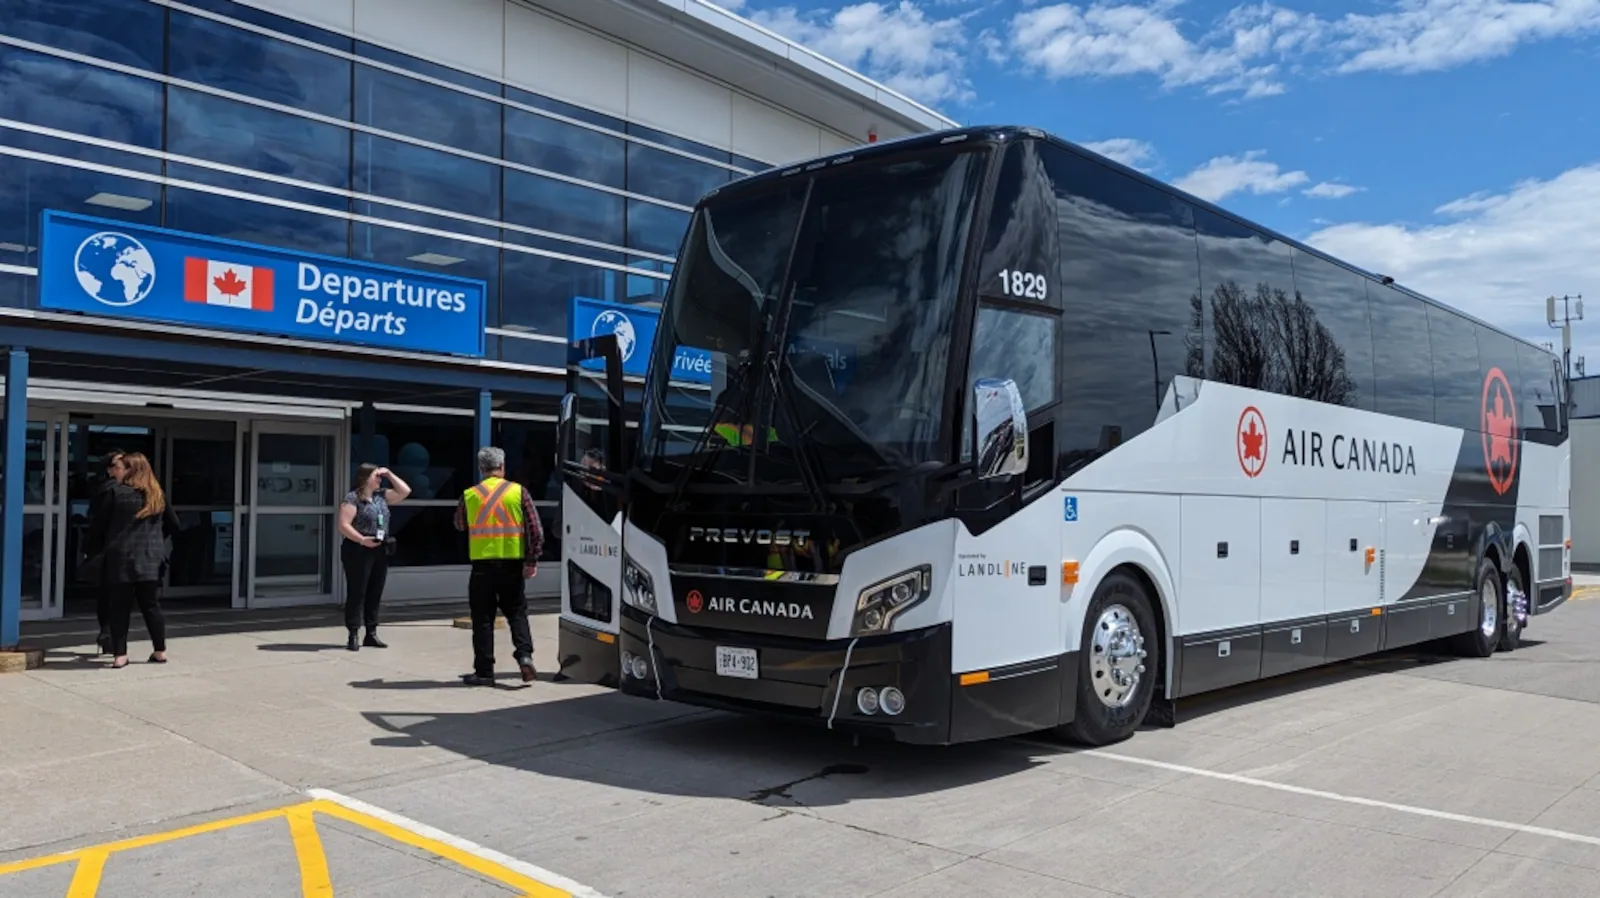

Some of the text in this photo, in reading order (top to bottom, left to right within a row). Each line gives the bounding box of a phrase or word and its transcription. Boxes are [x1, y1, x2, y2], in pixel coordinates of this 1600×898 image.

[298, 262, 466, 313] Departures
[999, 269, 1047, 300] 1829
[295, 298, 407, 336] Départs
[1282, 428, 1416, 476] AIR CANADA
[689, 526, 810, 546] PREVOST
[959, 560, 1026, 577] LANDLINE
[708, 597, 814, 620] AIR CANADA
